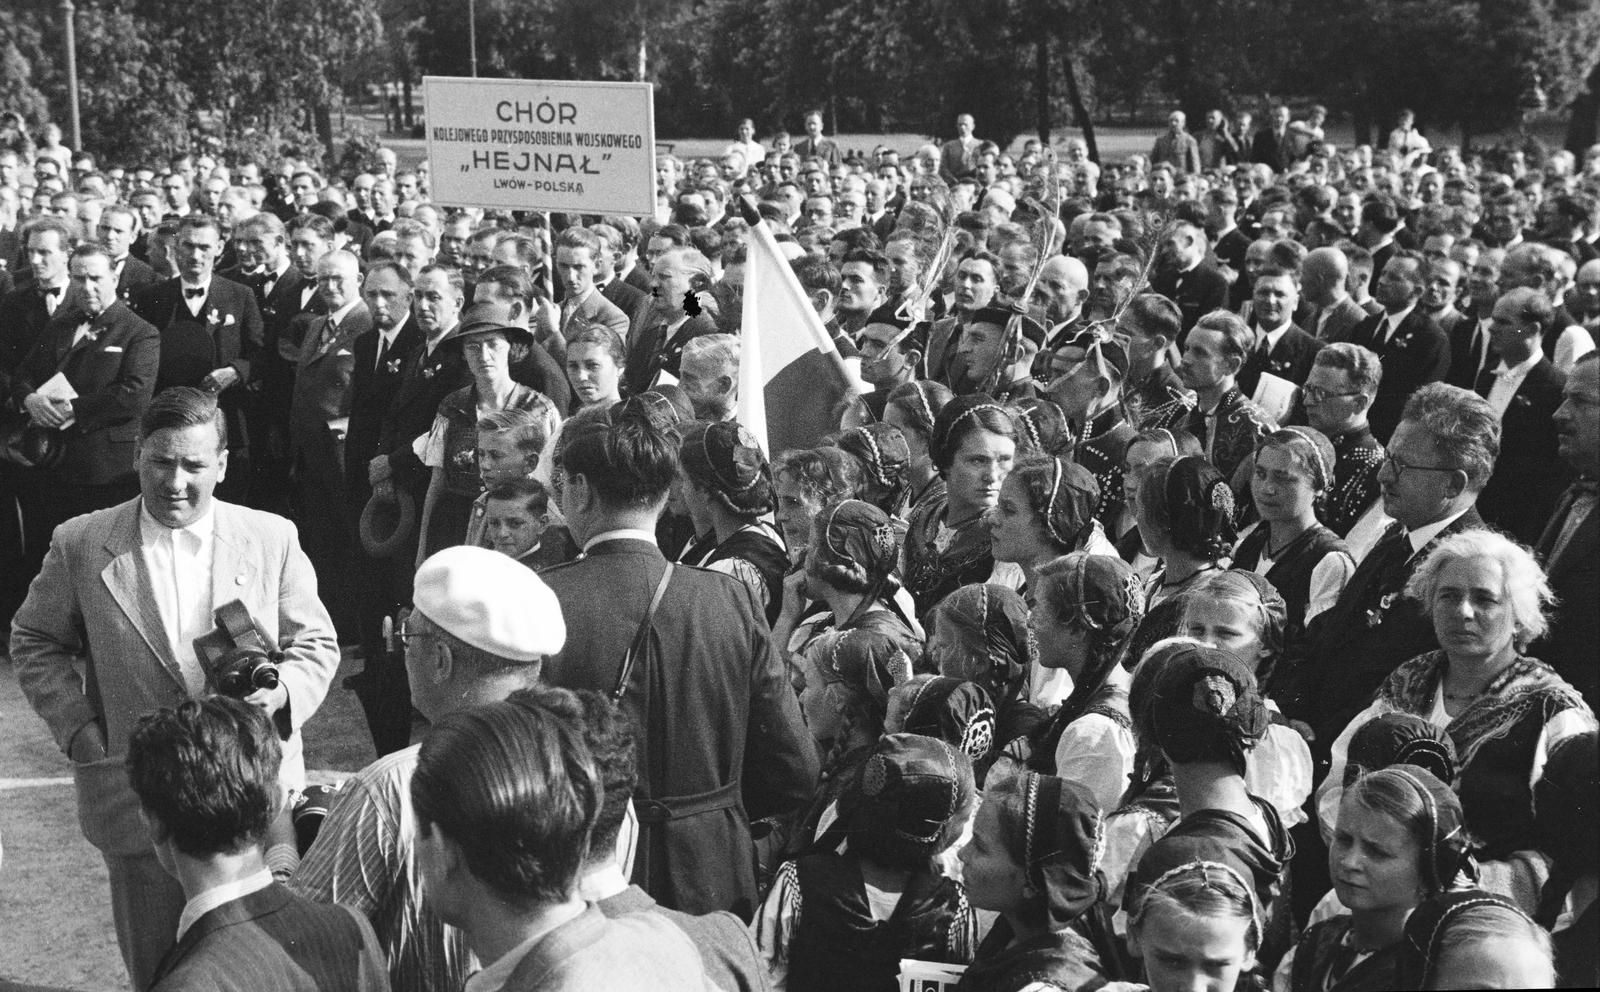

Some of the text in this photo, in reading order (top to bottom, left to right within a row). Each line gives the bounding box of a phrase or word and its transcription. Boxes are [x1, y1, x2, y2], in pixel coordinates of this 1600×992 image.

[496, 96, 577, 125] CHÓR
[433, 127, 642, 149] KOLEJOWEGO PRZYSPOSOBIENIA WOJSKOWEGO
